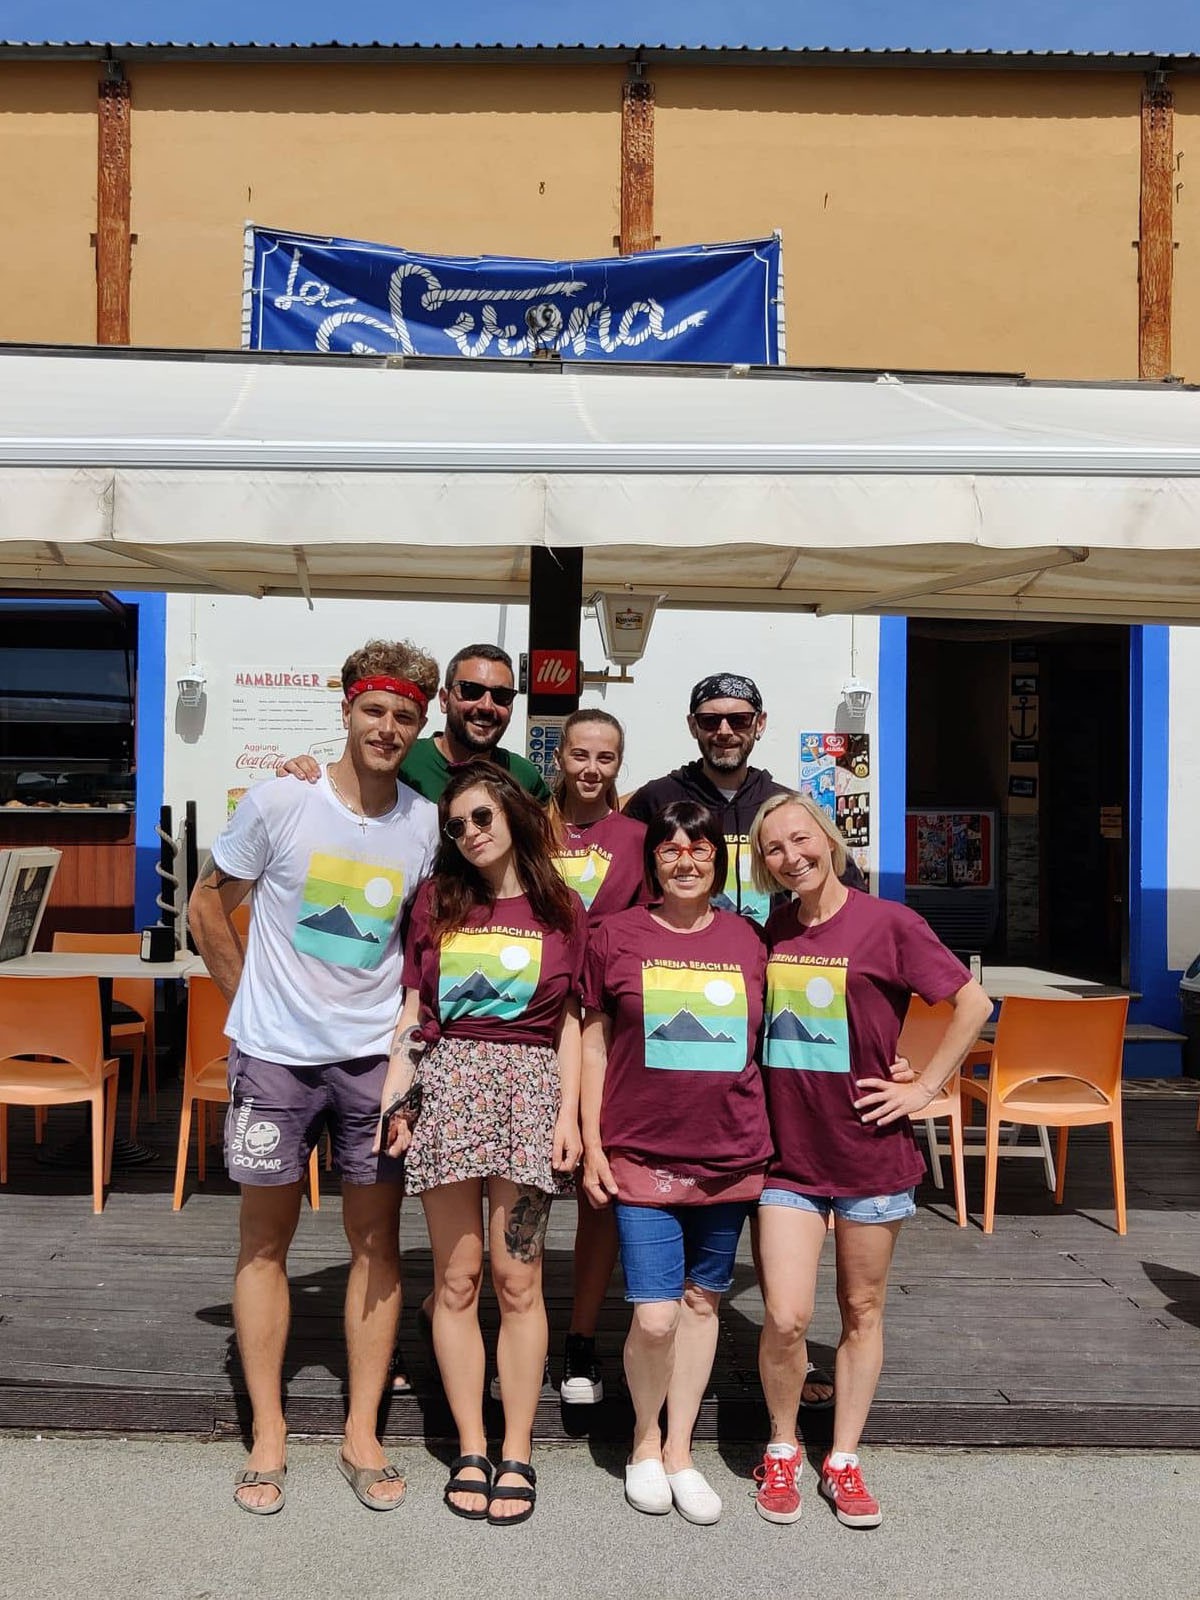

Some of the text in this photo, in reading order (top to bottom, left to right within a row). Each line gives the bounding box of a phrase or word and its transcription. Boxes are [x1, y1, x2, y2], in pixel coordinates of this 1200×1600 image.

[274, 248, 357, 310] La
[236, 672, 320, 687] HAMBURGER
[537, 659, 572, 688] illy
[244, 743, 280, 752] Aggiungi
[597, 846, 614, 861] BAR
[491, 925, 523, 937] BEACH
[524, 930, 543, 939] BAR
[641, 958, 742, 973] LA SIRENA BEACH BAR
[799, 955, 829, 966] BEACH
[829, 957, 849, 967] BAR
[232, 1153, 282, 1170] GOLMAR
